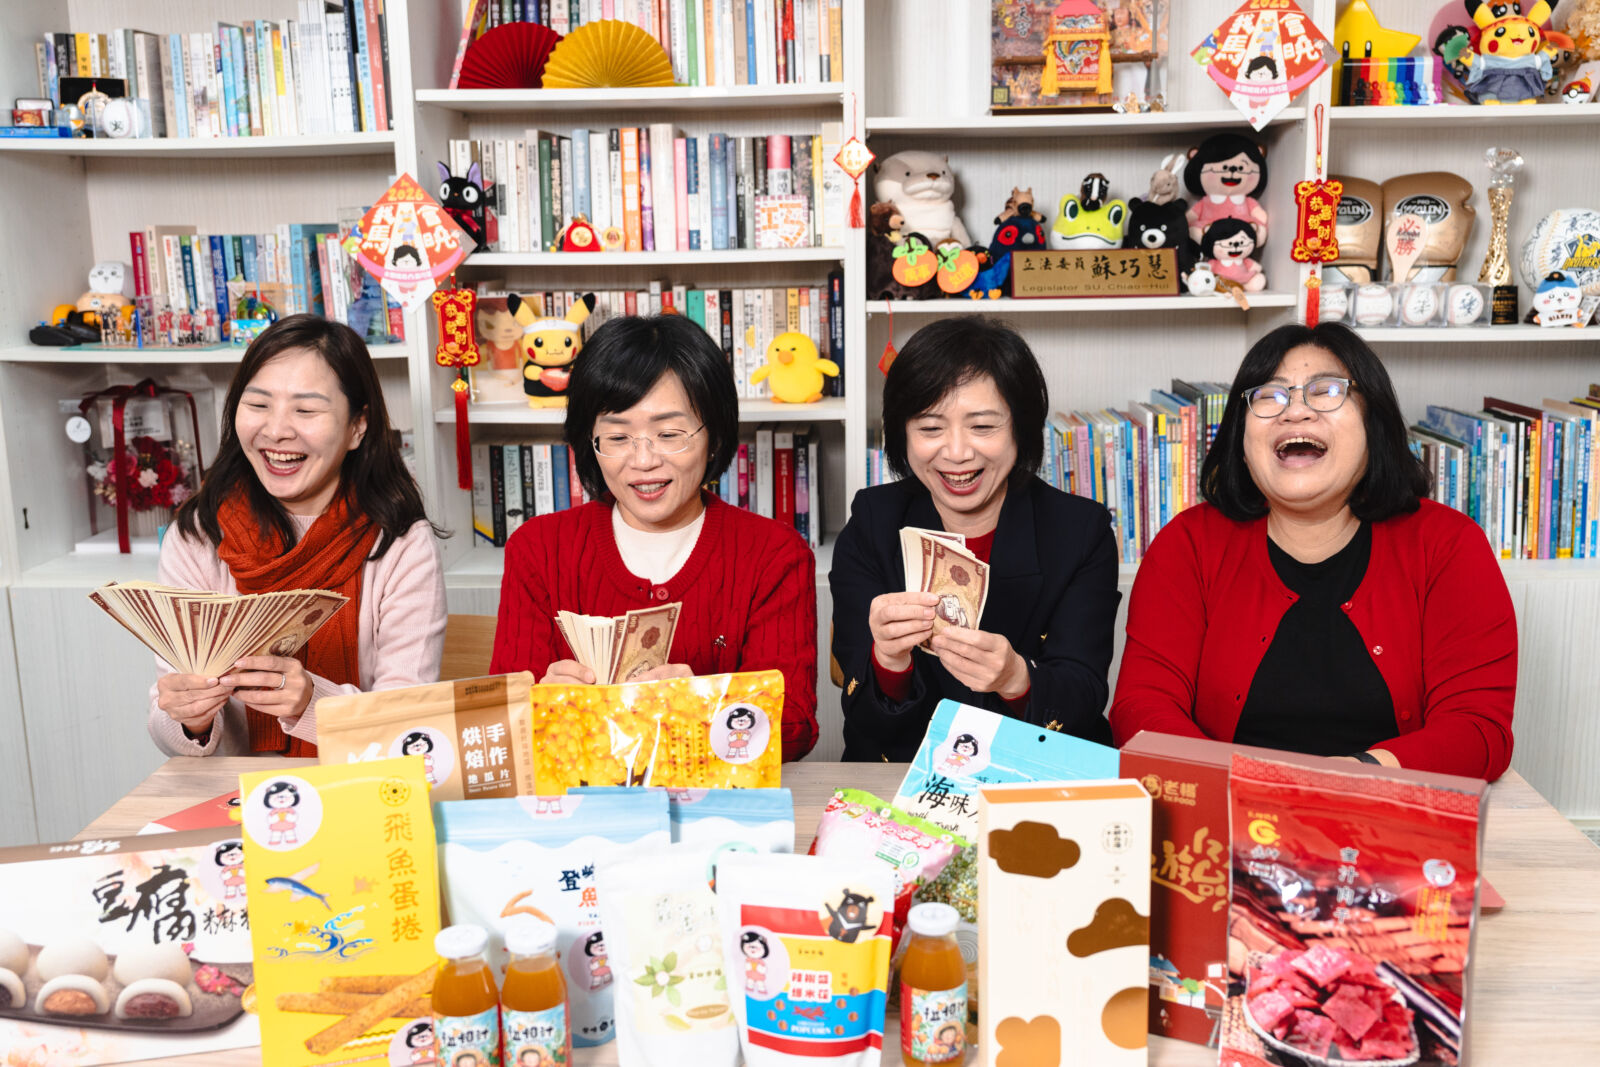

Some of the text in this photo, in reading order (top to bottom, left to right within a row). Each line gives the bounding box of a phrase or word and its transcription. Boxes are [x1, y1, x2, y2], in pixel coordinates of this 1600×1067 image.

[388, 187, 425, 201] 2026
[1022, 254, 1169, 280] 立法委員 蘇巧慧
[462, 726, 485, 770] 烘焙
[486, 723, 509, 766] 手作
[918, 773, 978, 818] 海味
[384, 813, 423, 943] 飛魚蛋捲
[92, 864, 197, 945] 豆腐
